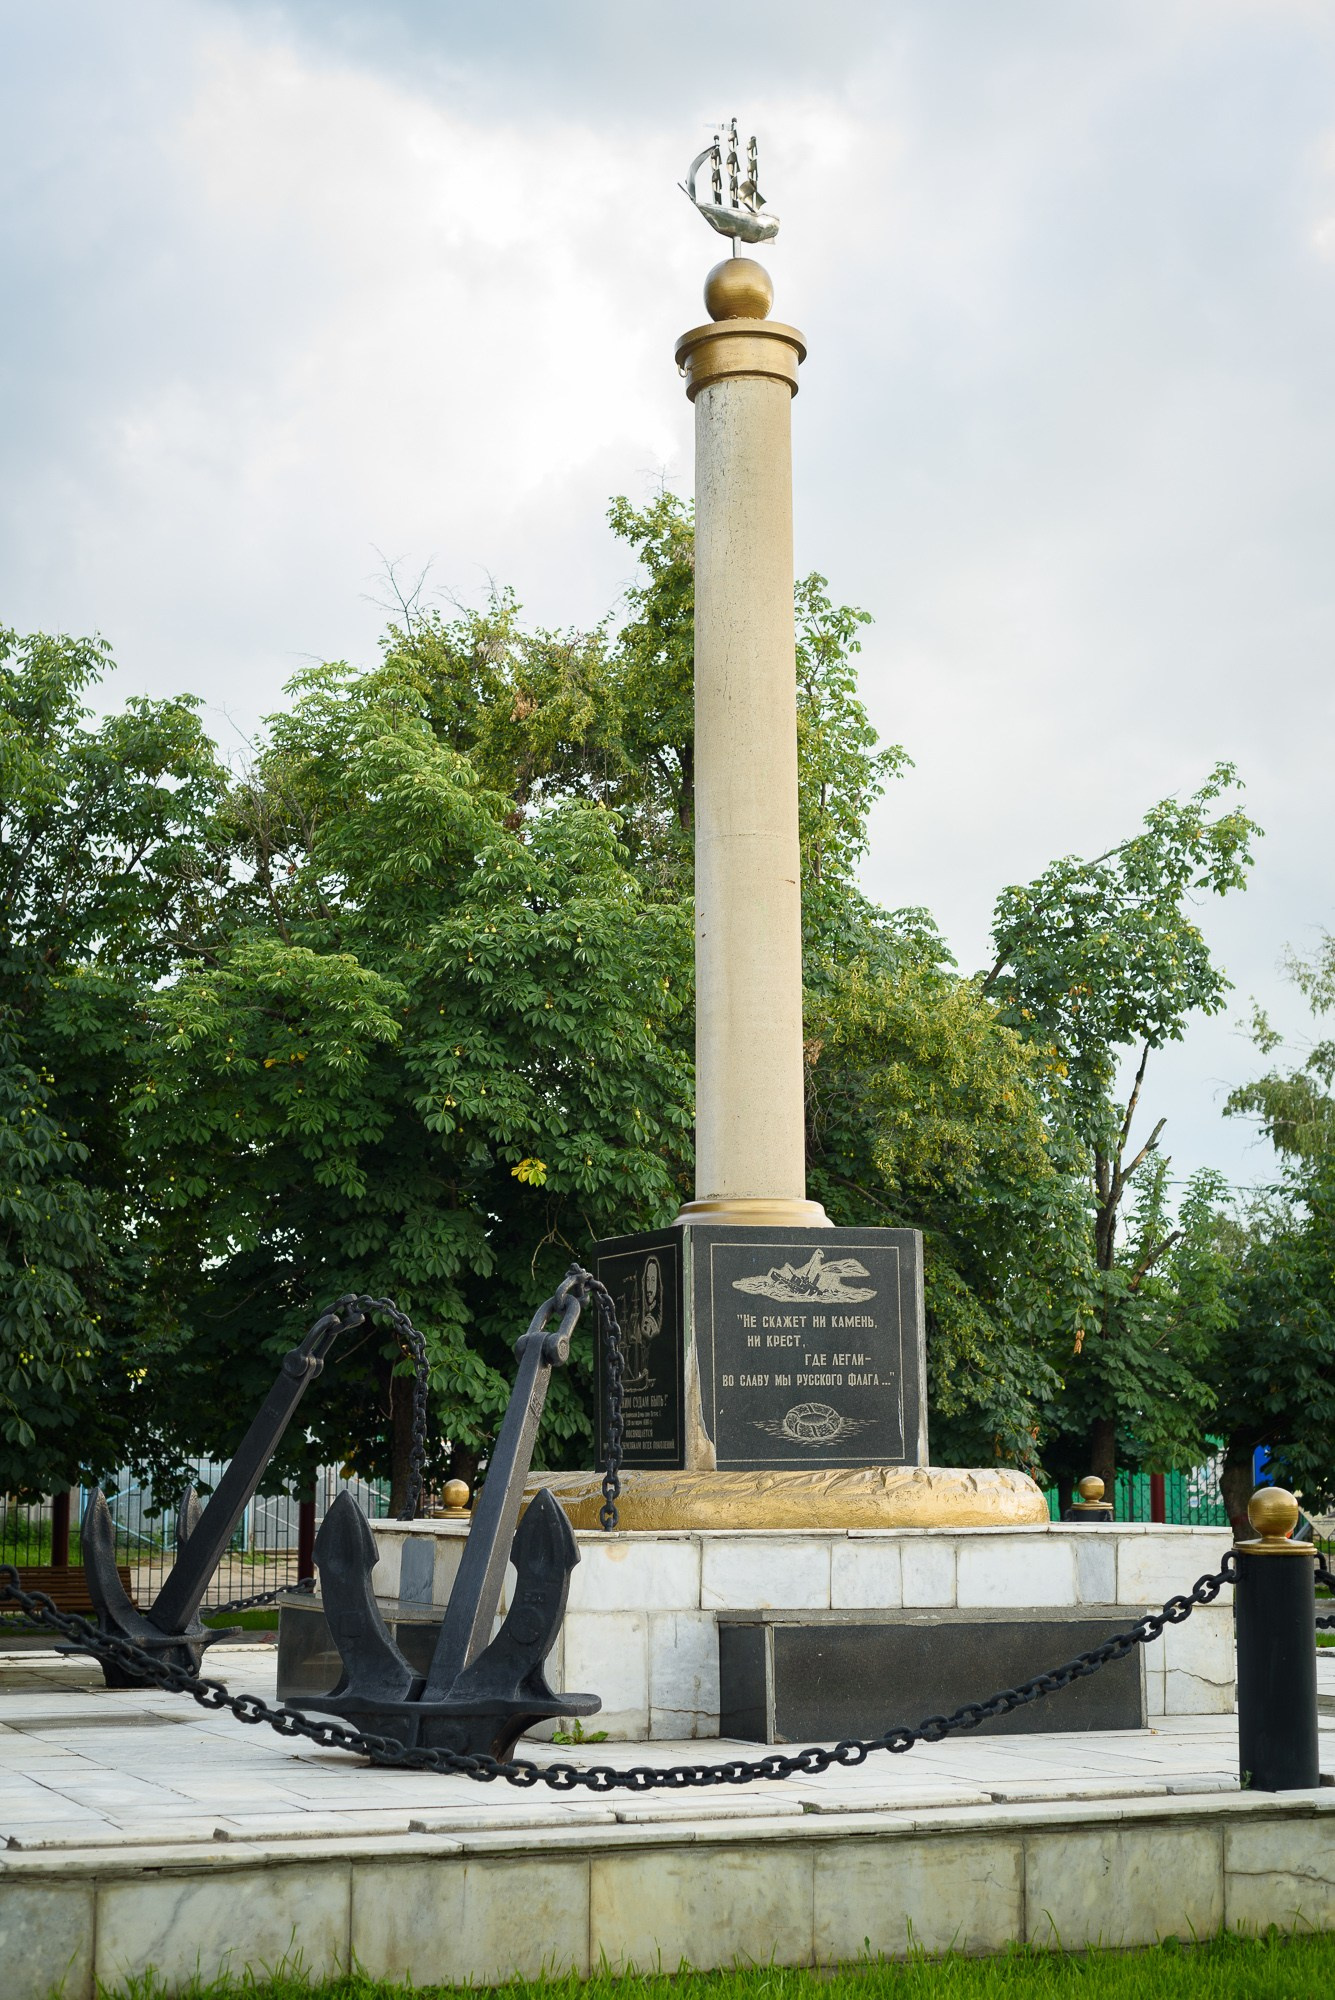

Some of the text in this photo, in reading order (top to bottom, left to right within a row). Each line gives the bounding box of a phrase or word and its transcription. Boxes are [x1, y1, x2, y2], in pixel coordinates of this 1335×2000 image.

[763, 1316, 807, 1328] СКАЖЕТ
[813, 1316, 826, 1328] НИ
[832, 1316, 878, 1329] КАМЕНЬ,
[748, 1335, 807, 1349] НИ КРЕСТ,
[805, 1354, 827, 1367] ГДЕ
[723, 1374, 734, 1387] ВО
[740, 1374, 769, 1387] СЛАВУ
[775, 1374, 791, 1387] МЫ
[797, 1374, 842, 1386] РУССКОГО
